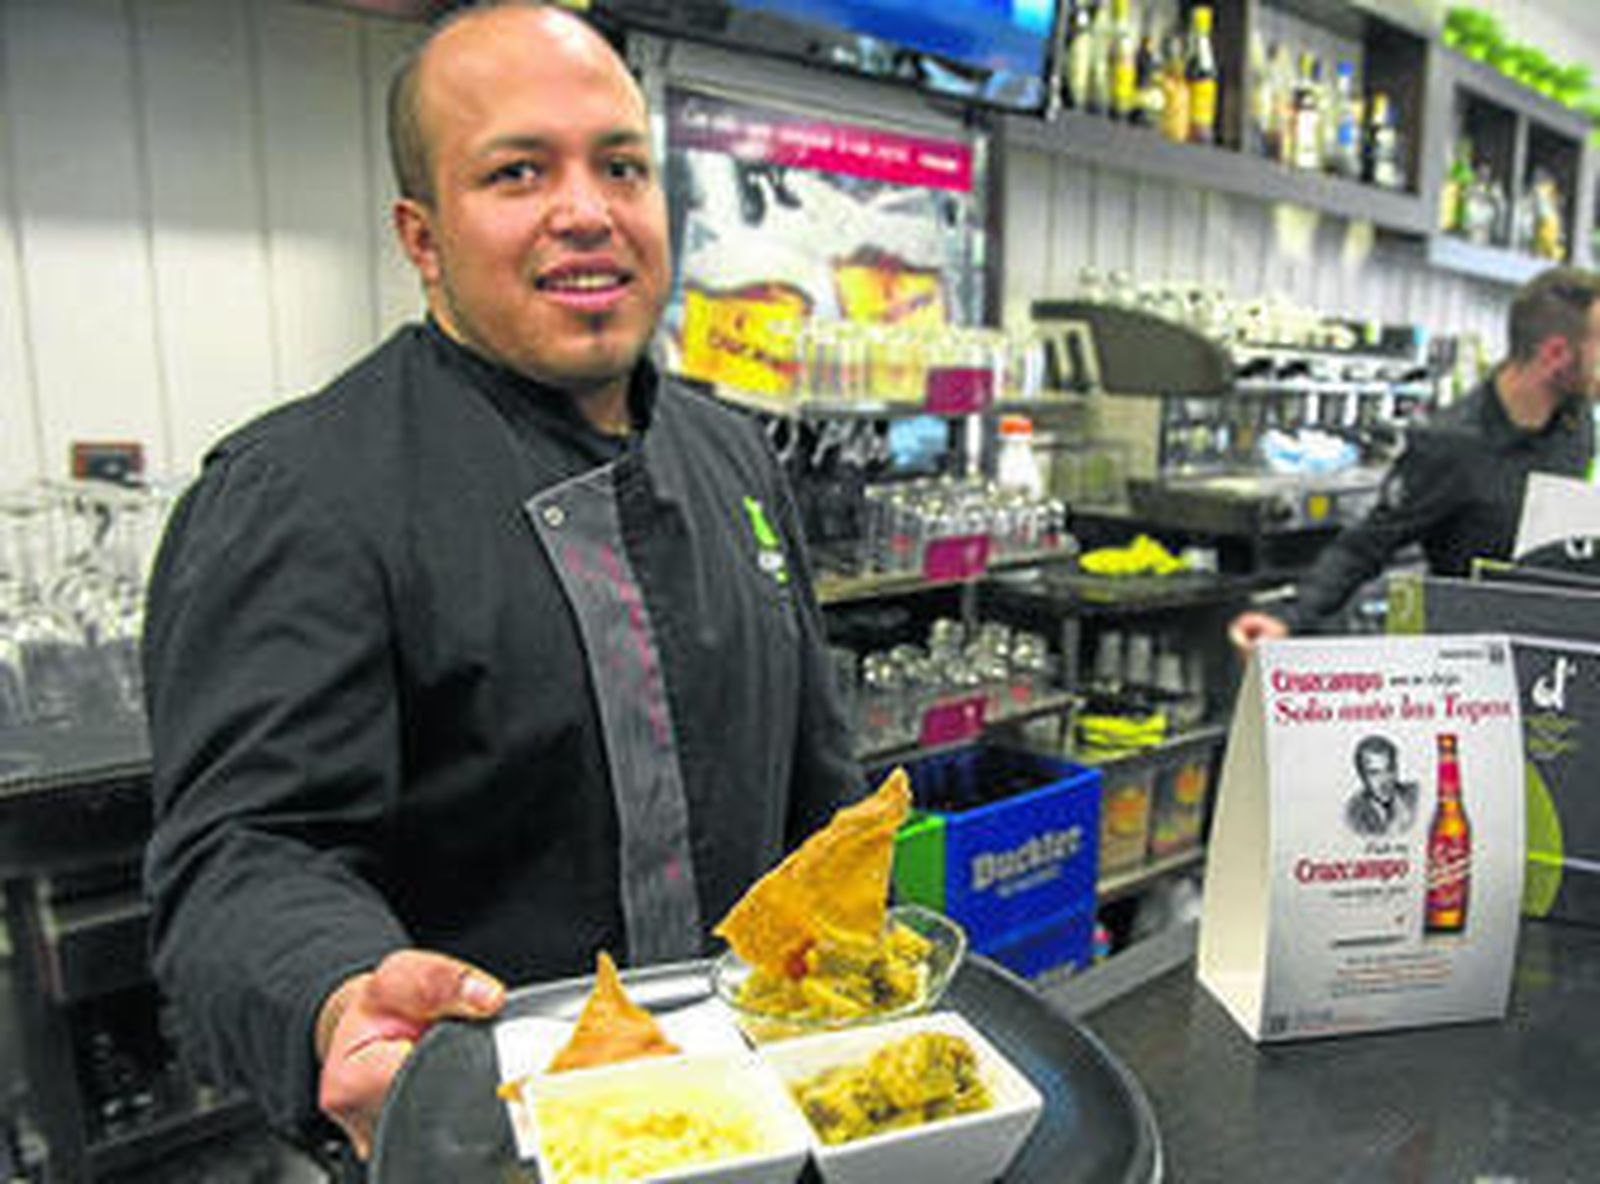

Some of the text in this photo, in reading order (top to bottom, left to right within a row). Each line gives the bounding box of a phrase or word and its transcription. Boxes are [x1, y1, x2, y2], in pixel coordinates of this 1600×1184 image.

[1271, 668, 1384, 694] Cruzcampo
[1274, 697, 1333, 724] Solo
[1294, 857, 1410, 883] Cruzcampo
